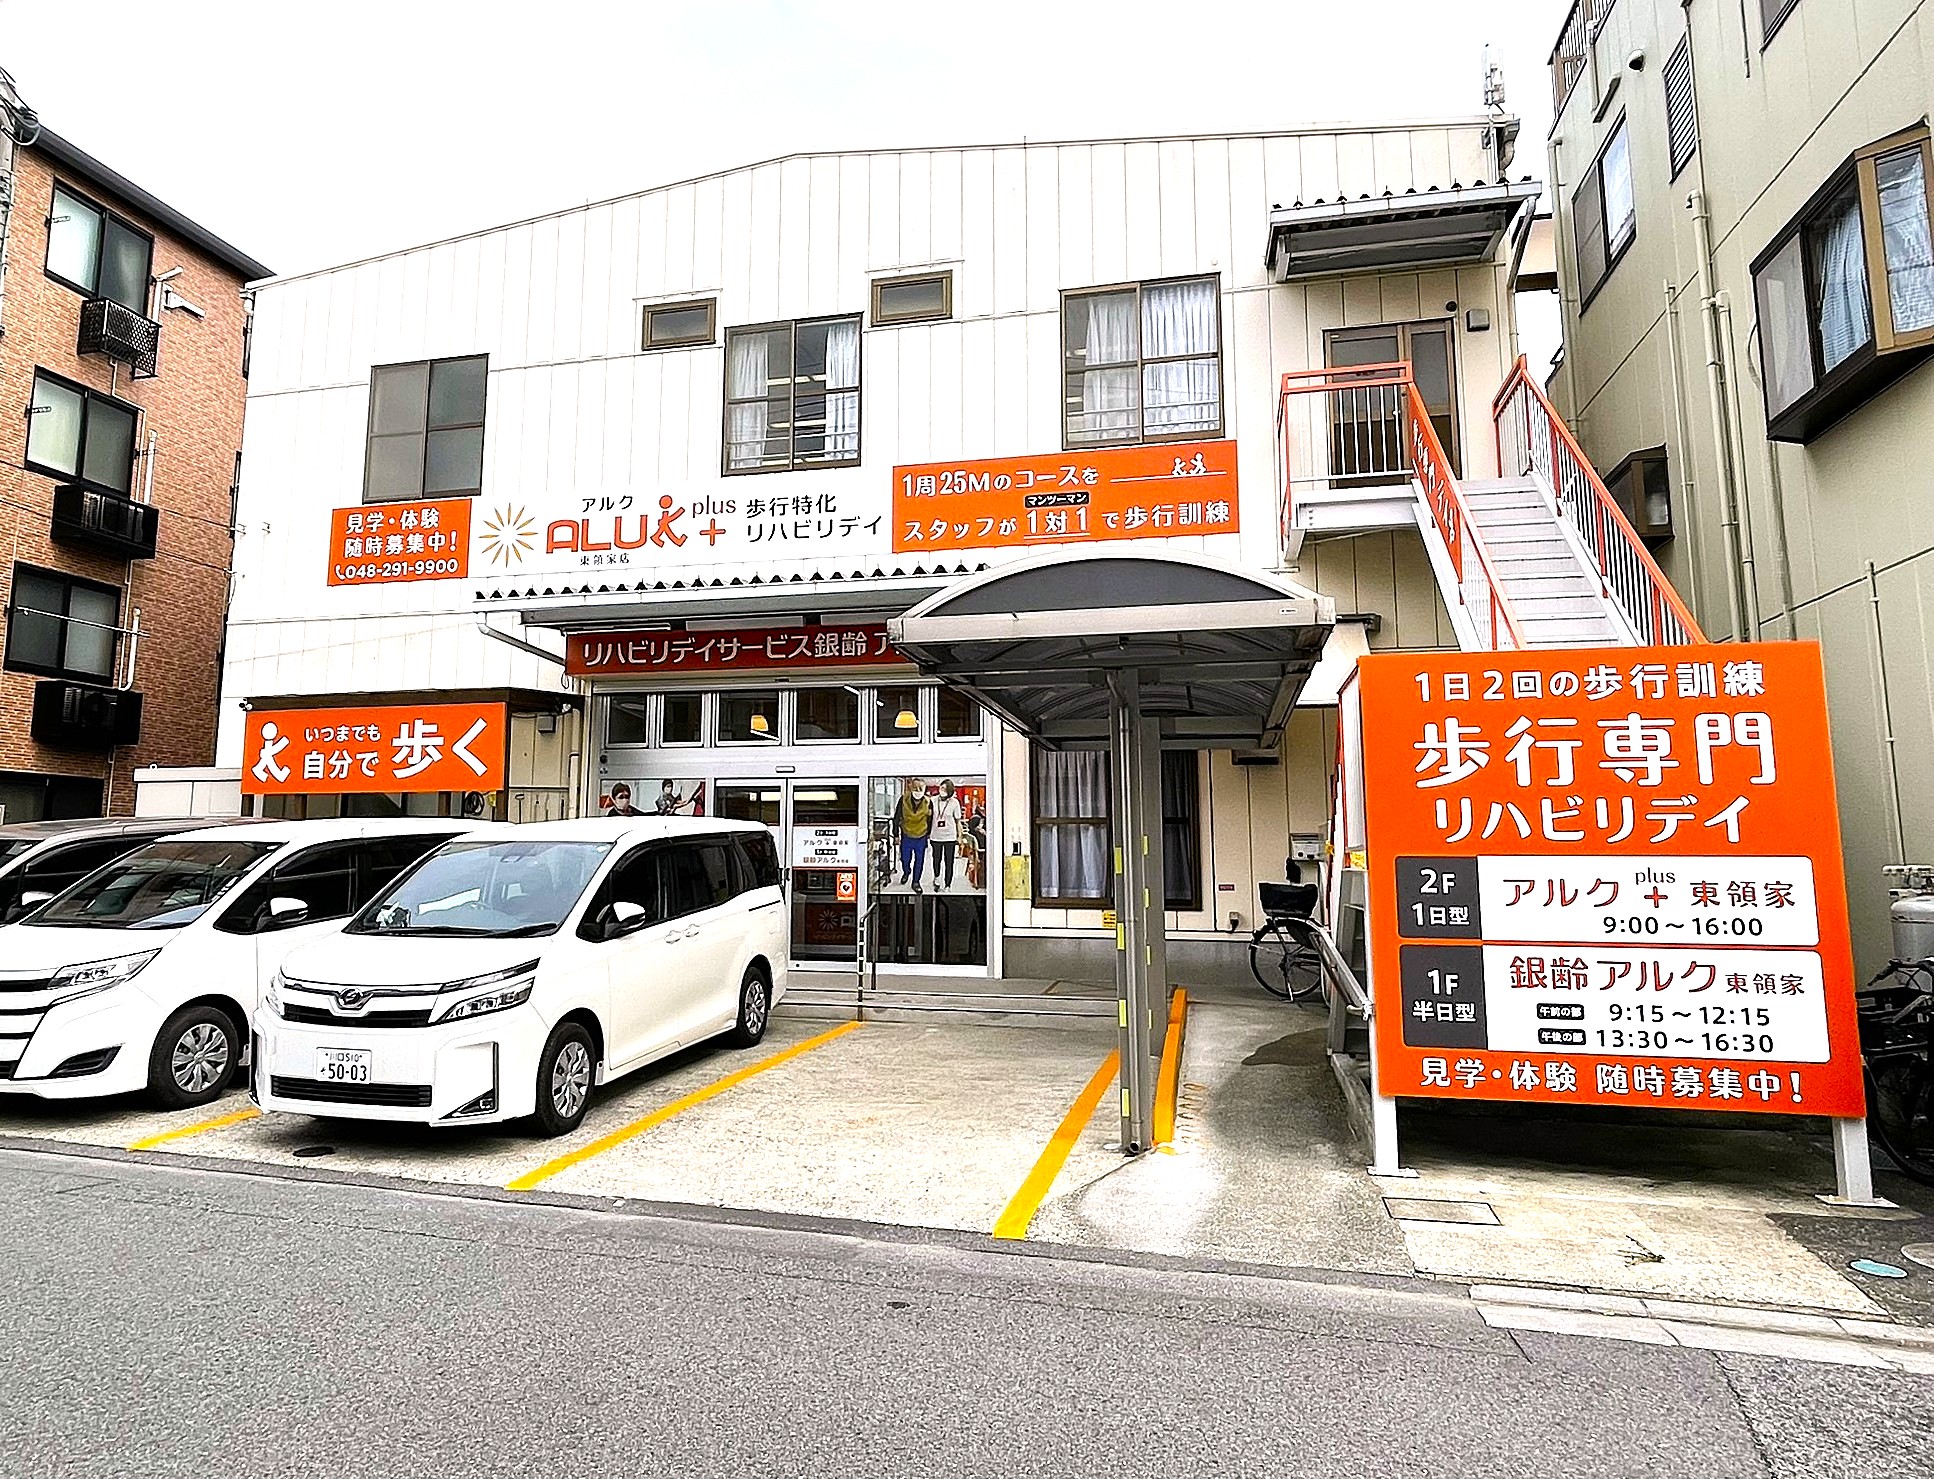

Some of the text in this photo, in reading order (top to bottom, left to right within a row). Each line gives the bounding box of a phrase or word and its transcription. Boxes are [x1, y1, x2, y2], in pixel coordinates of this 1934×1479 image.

[582, 495, 633, 513] アルク
[692, 494, 737, 518] plus
[746, 494, 836, 518] 歩行特化
[1027, 493, 1087, 506] マンツーマン
[345, 507, 440, 535] 見学・体験
[747, 515, 882, 543] リハビリデイ
[344, 530, 458, 558] 随時募集中!
[345, 558, 459, 579] 048-291-9900
[1414, 660, 1766, 702] 1日2回の歩行訓練
[304, 724, 381, 743] いつまでも
[391, 717, 488, 779] 歩く
[1413, 712, 1777, 789] 歩行専門
[303, 749, 379, 780] 自分で
[1434, 794, 1750, 844] リハビリデイ
[1419, 867, 1456, 894] 2F
[1635, 867, 1676, 886] plus
[1503, 878, 1619, 907] アルク
[1690, 880, 1796, 908] 東領家
[1411, 901, 1471, 926] 1日型
[1427, 968, 1459, 996] 1F
[1725, 973, 1805, 996] 東領家
[1412, 999, 1477, 1023] 半日型
[328, 1063, 367, 1081] 50-03
[1420, 1056, 1803, 1104] 見学・体験 随時募集中!
